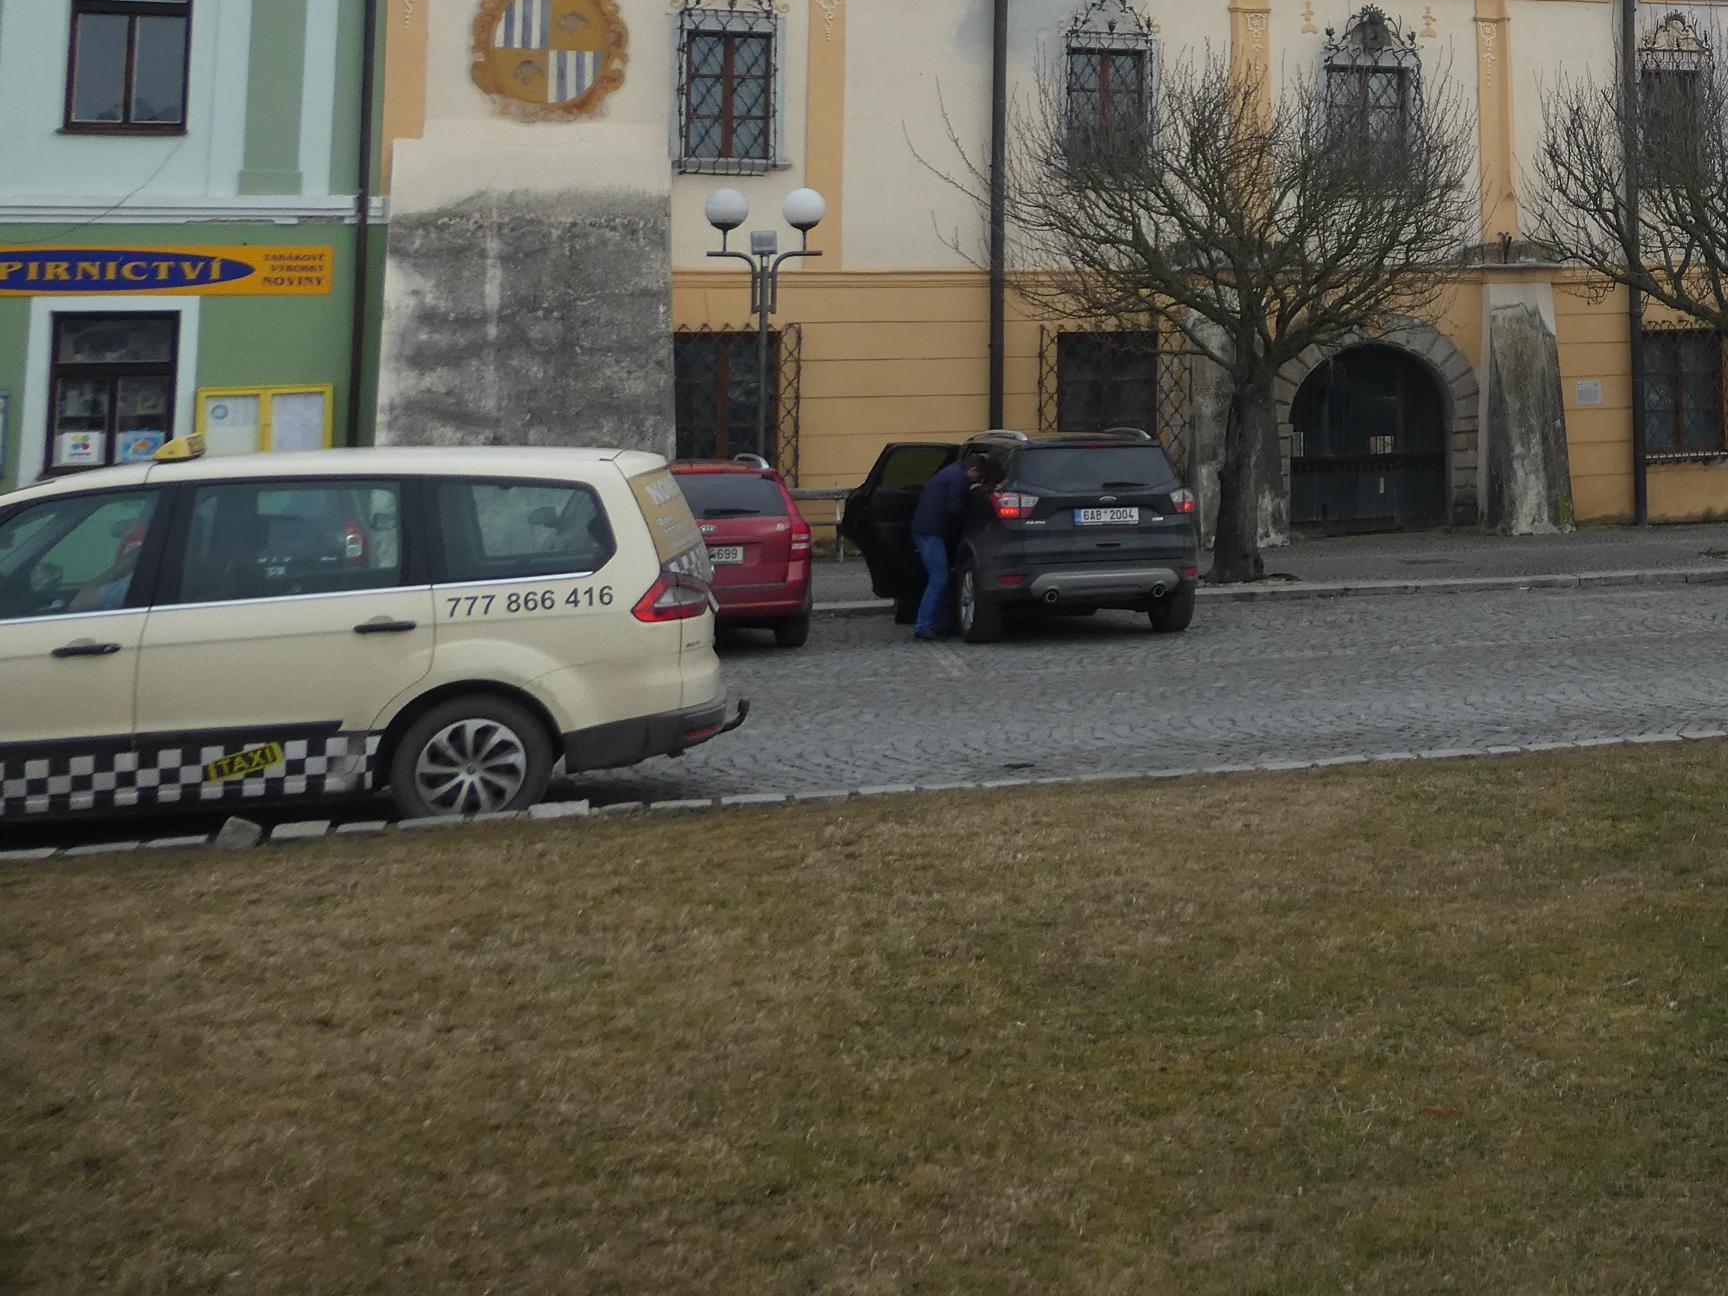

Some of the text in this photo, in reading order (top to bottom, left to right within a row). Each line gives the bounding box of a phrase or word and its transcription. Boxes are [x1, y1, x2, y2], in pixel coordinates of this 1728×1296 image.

[1083, 508, 1134, 521] 6AB 2004
[446, 585, 614, 618] 777 866 416
[214, 746, 277, 778] TAXI
